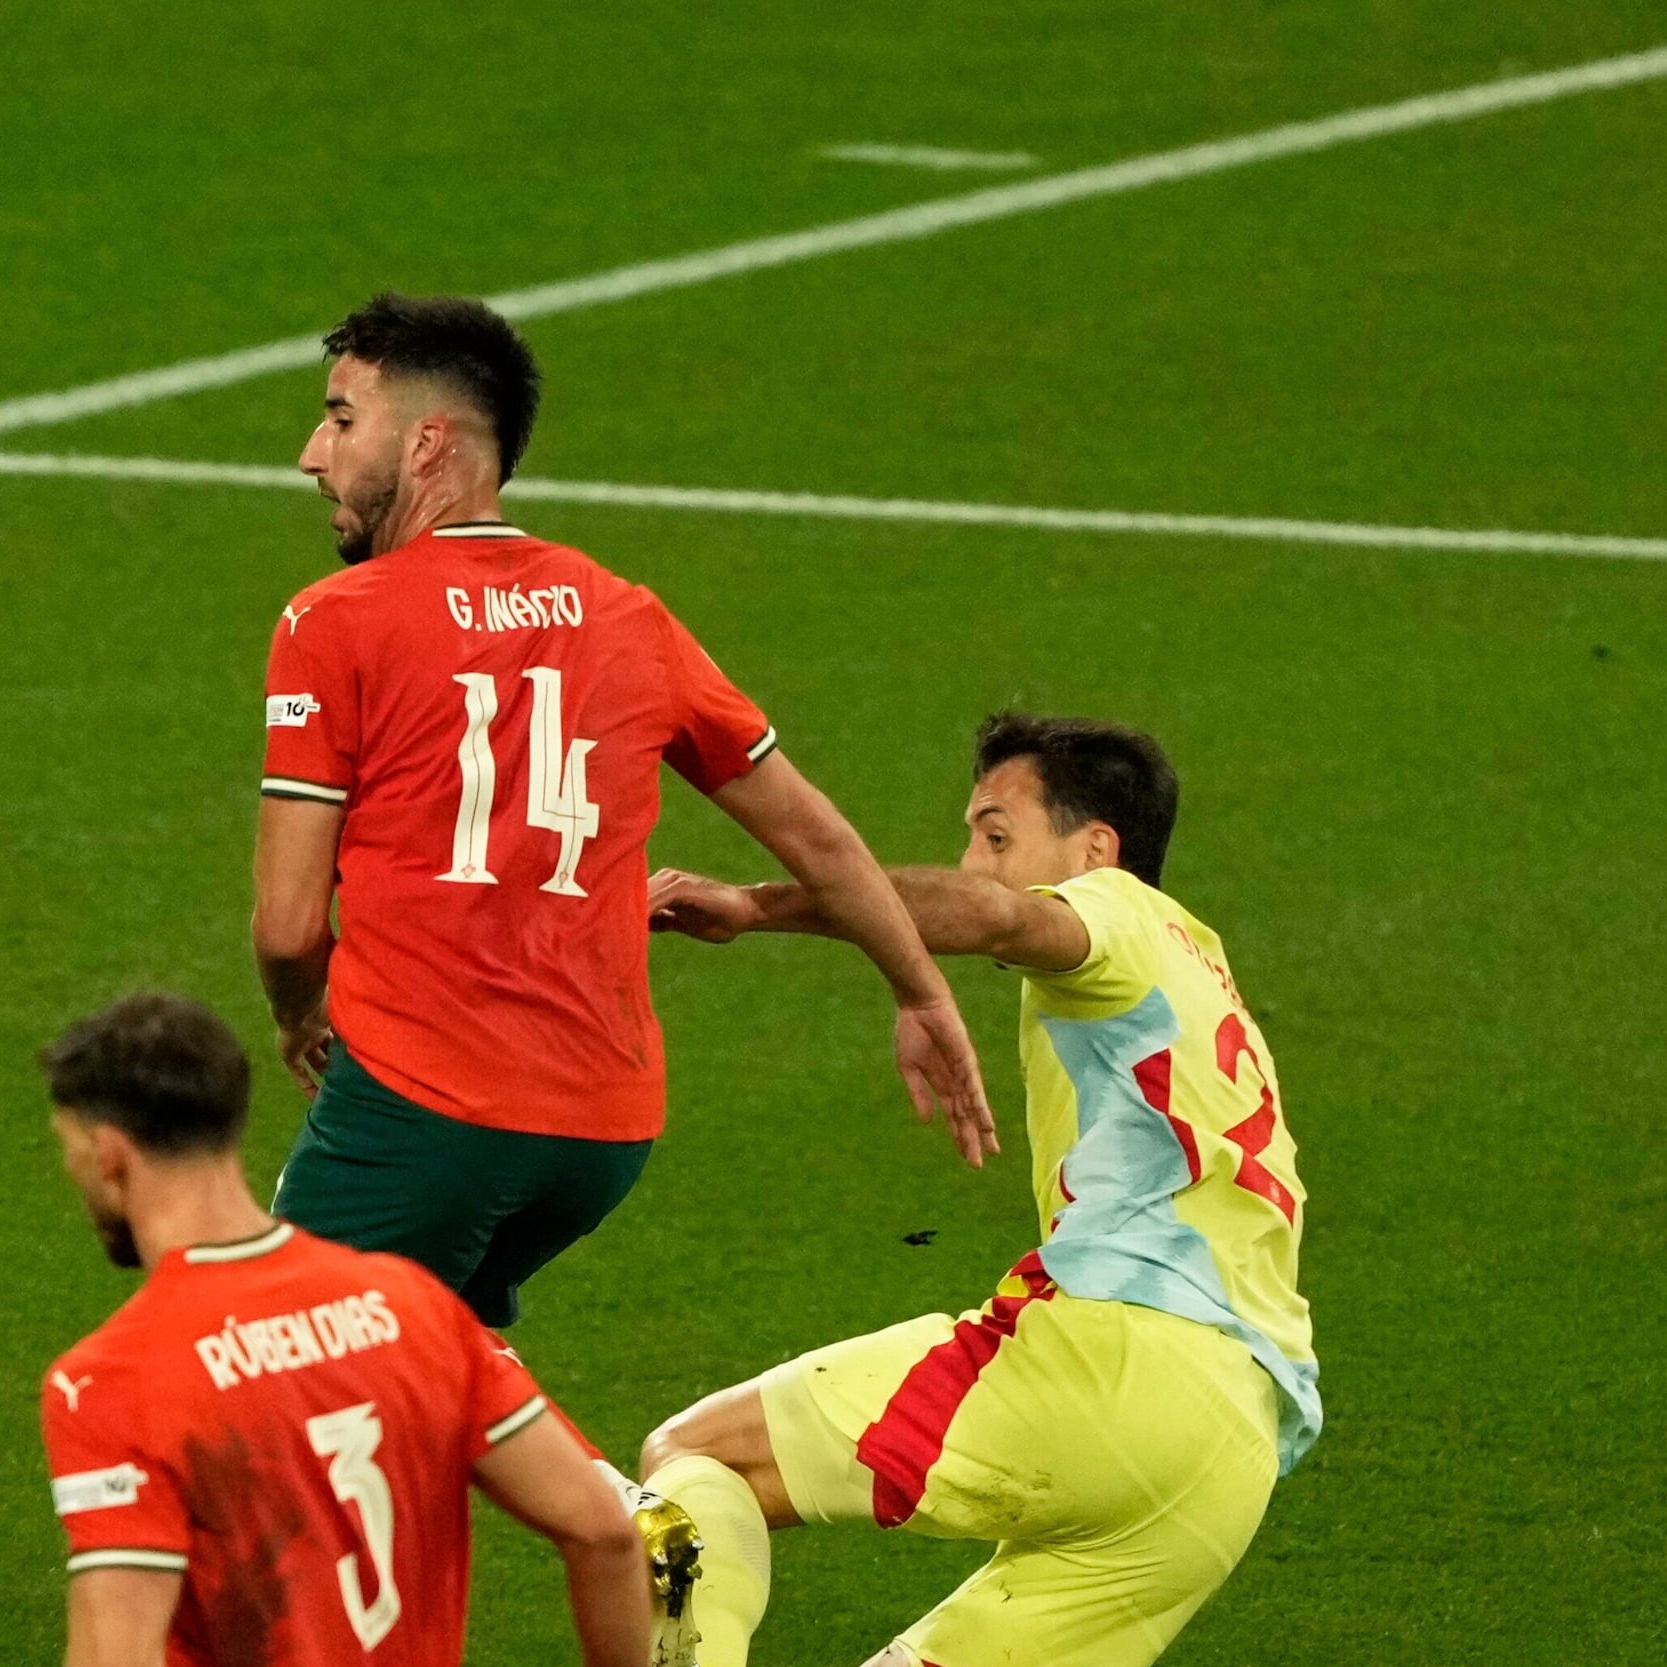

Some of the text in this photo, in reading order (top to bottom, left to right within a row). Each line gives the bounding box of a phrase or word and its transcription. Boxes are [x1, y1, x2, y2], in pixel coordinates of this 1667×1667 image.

[434, 665, 599, 897] 14
[195, 1289, 401, 1391] RÚBEN DIAS
[305, 1400, 402, 1652] 3
